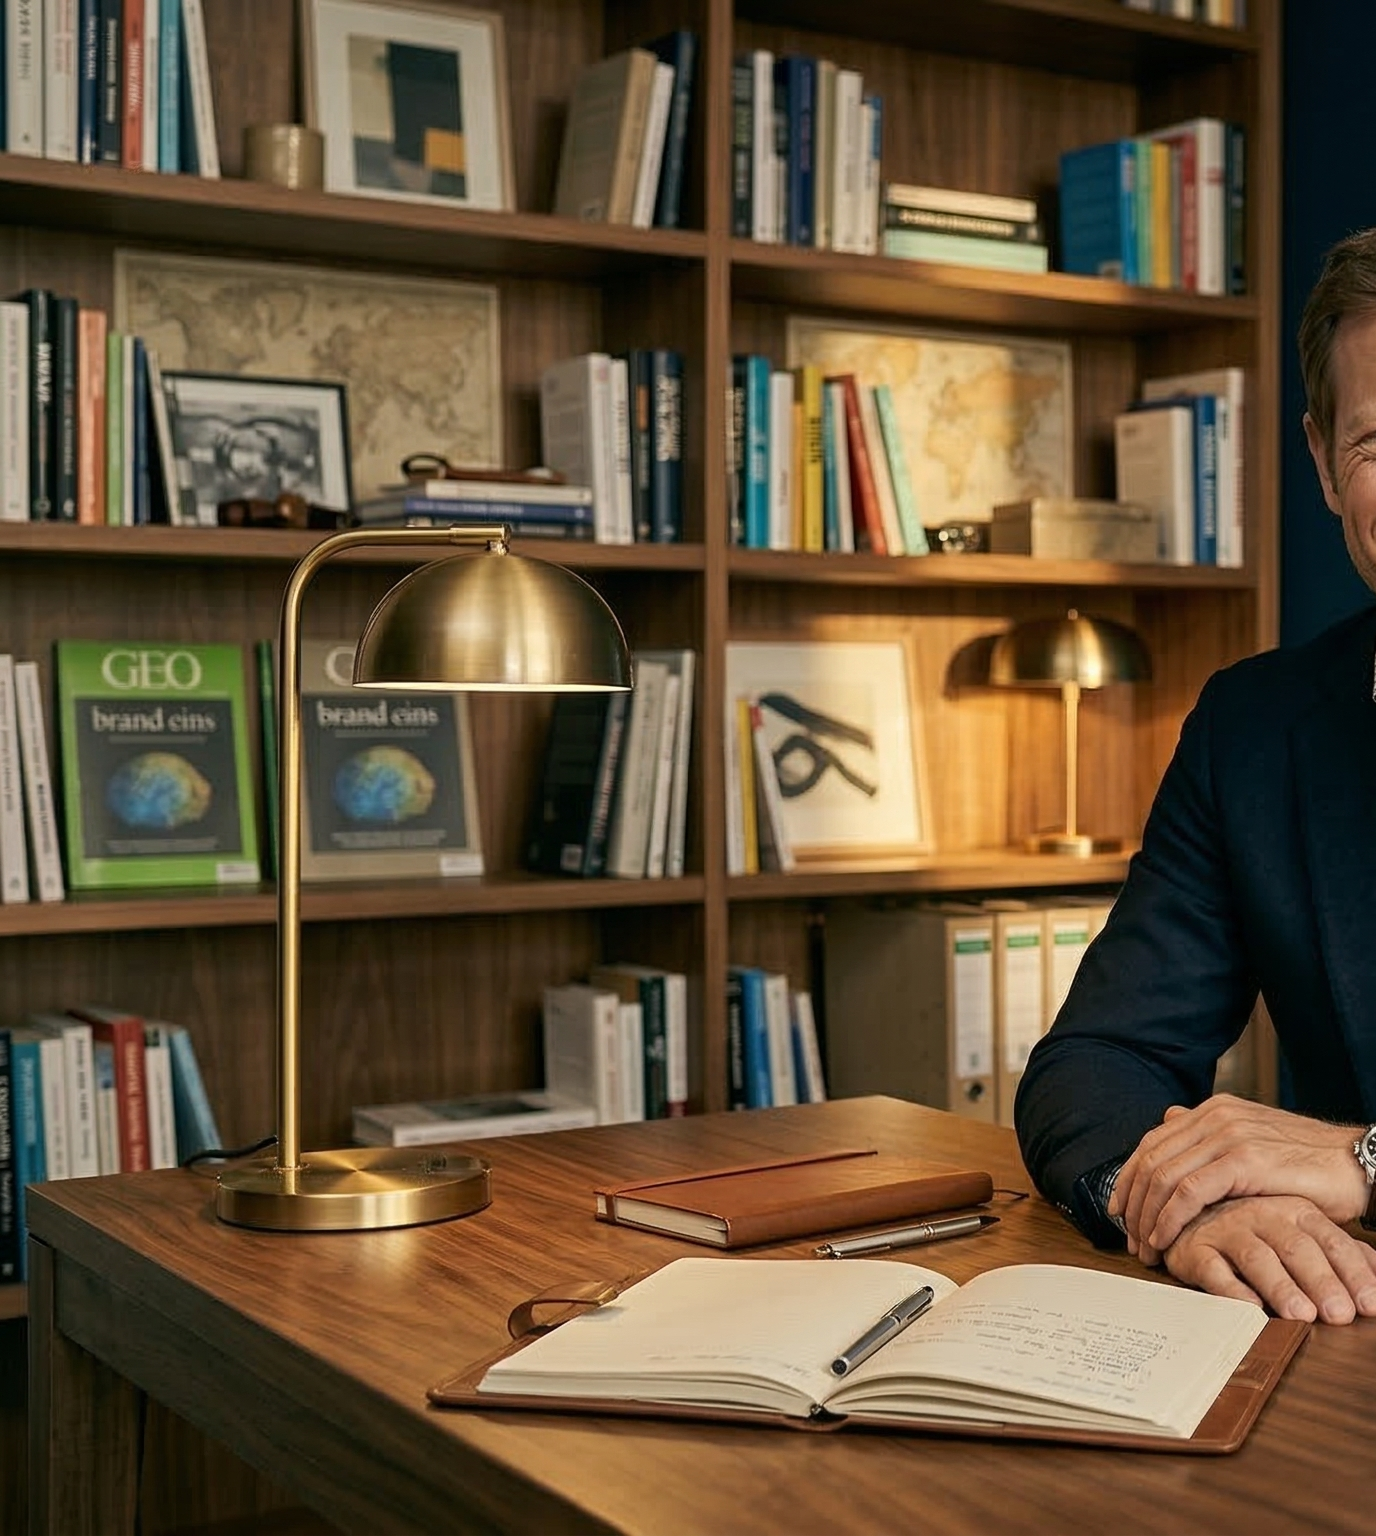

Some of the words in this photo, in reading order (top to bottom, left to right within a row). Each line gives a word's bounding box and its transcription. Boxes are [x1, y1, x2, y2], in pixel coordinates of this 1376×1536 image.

[102, 650, 202, 690] GEO
[92, 705, 165, 732] brand
[168, 706, 217, 733] eins
[316, 699, 388, 728] brand
[390, 700, 440, 728] eins
